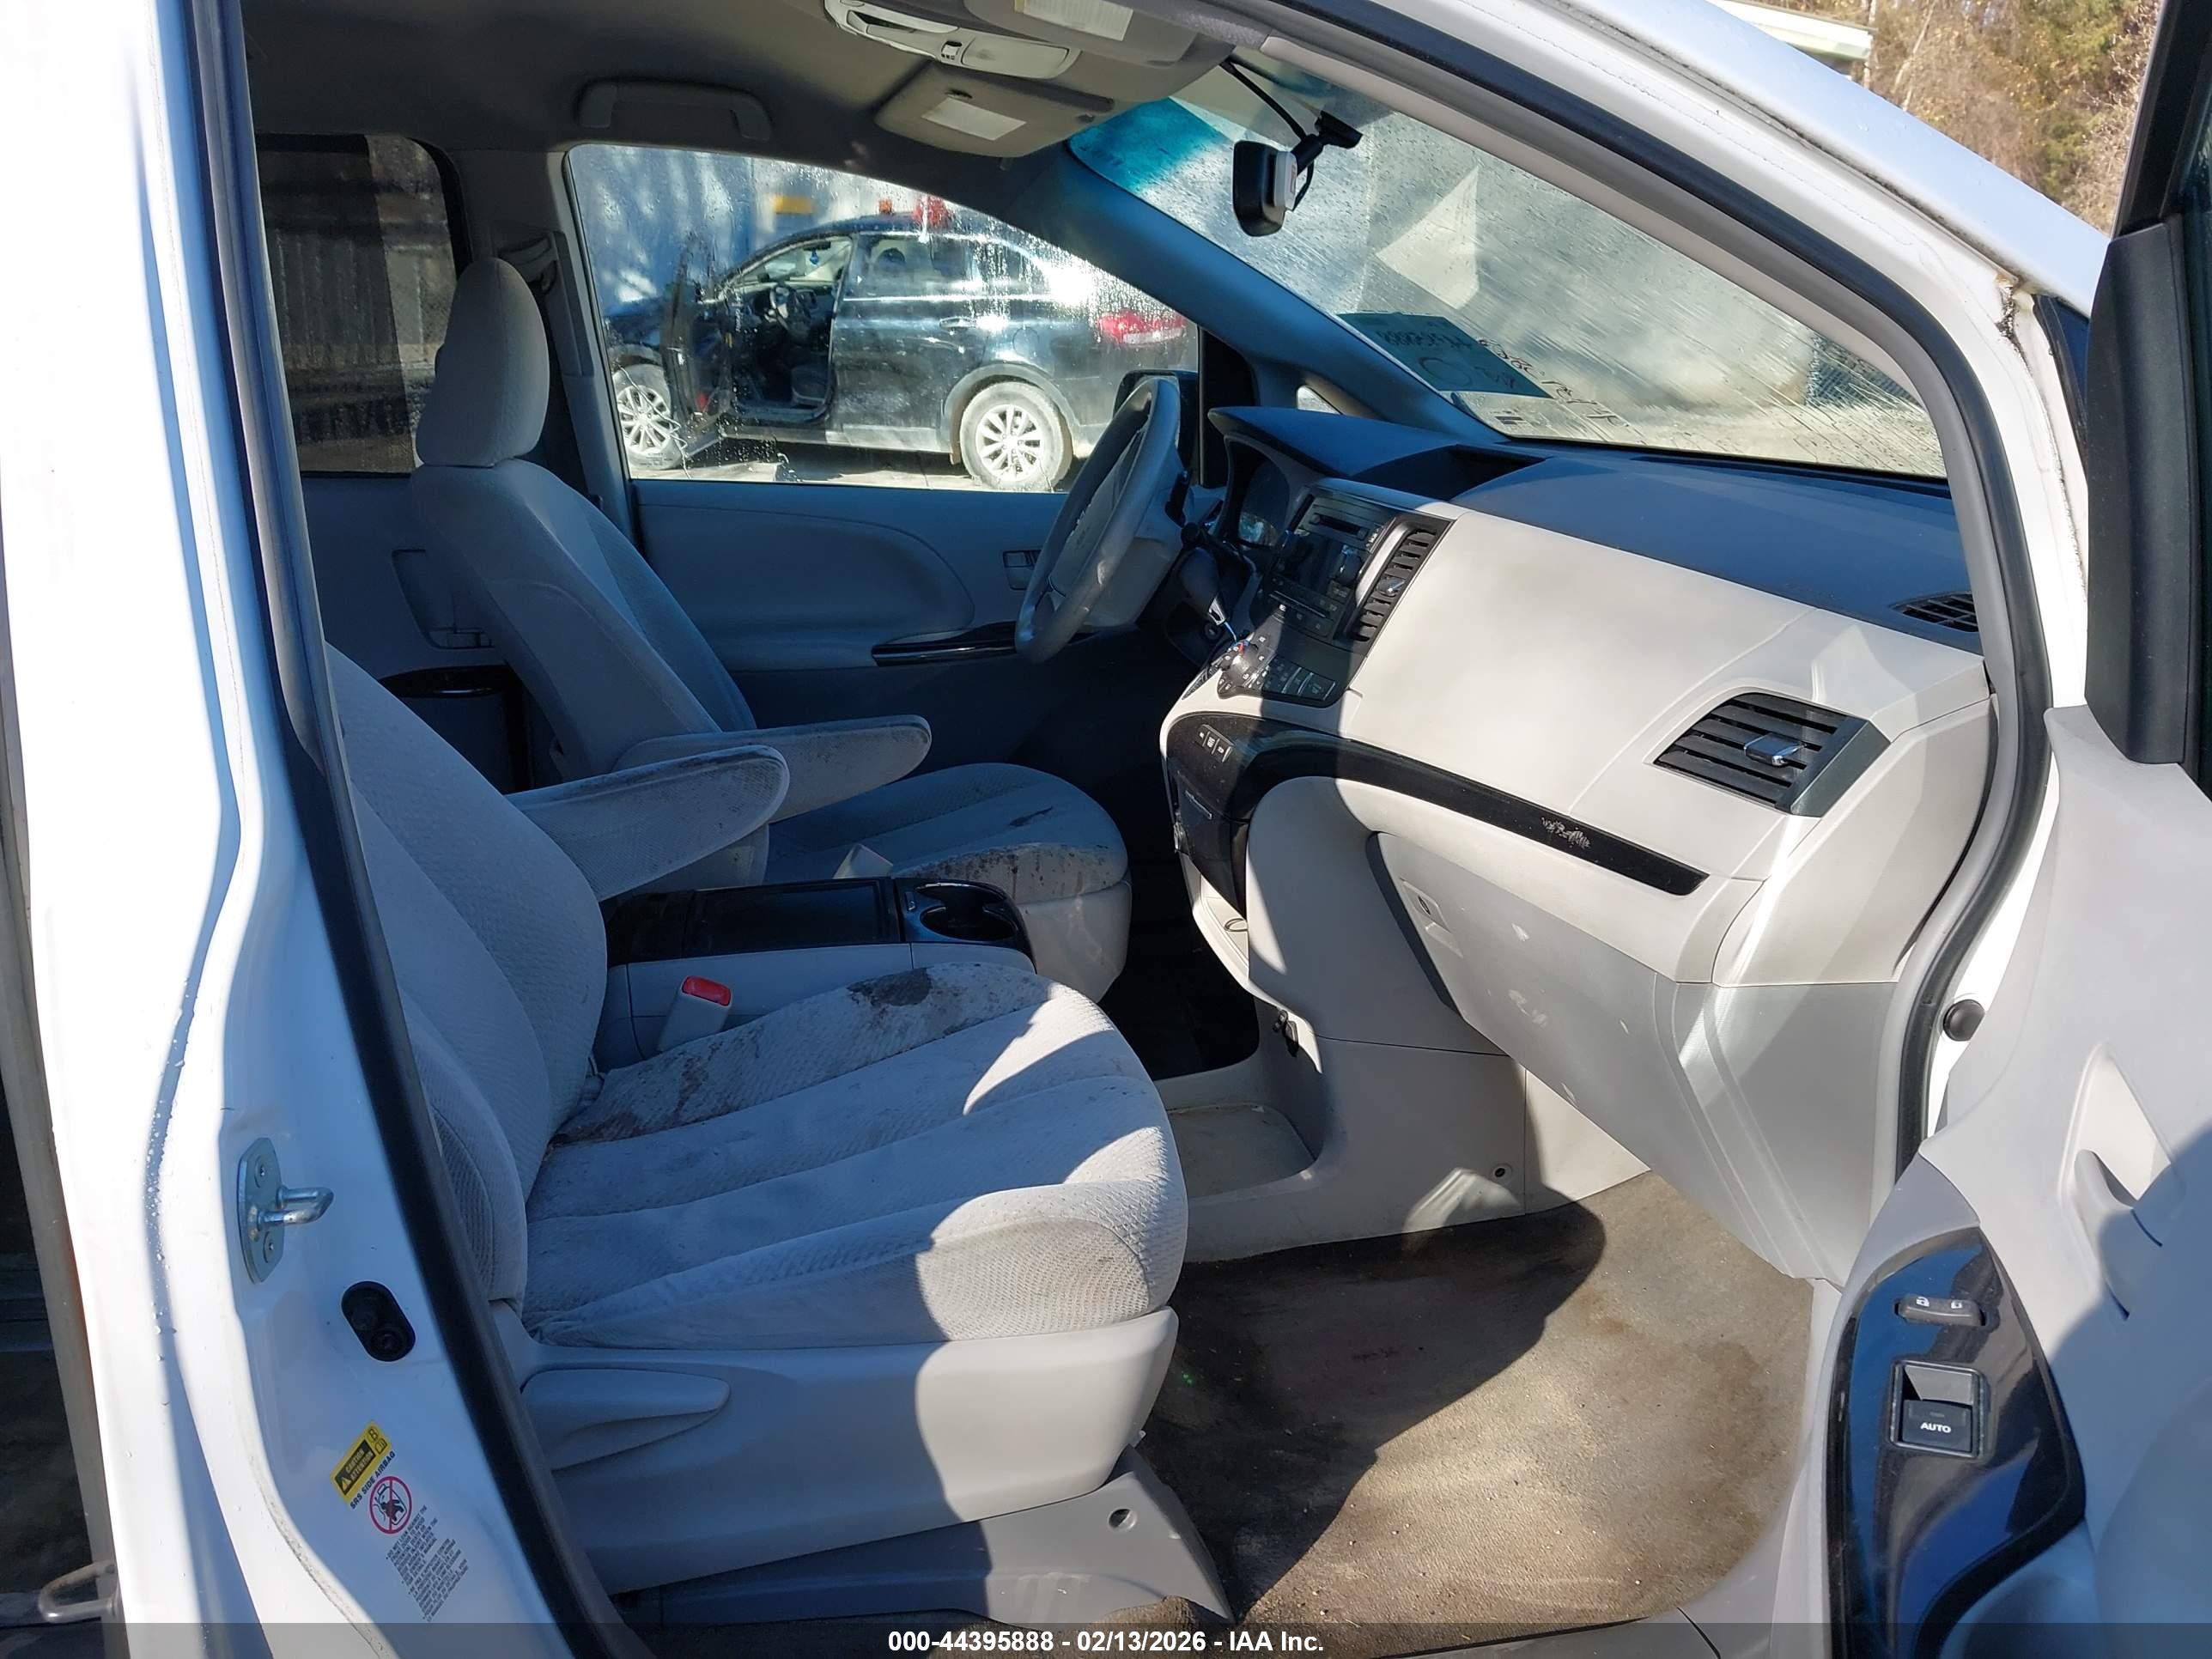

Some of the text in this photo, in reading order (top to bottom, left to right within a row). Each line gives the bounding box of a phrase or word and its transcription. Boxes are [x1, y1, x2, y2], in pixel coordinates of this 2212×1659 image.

[1920, 1422, 1951, 1433] AUTO
[350, 1451, 396, 1509] SRS SIDE AIRBAG
